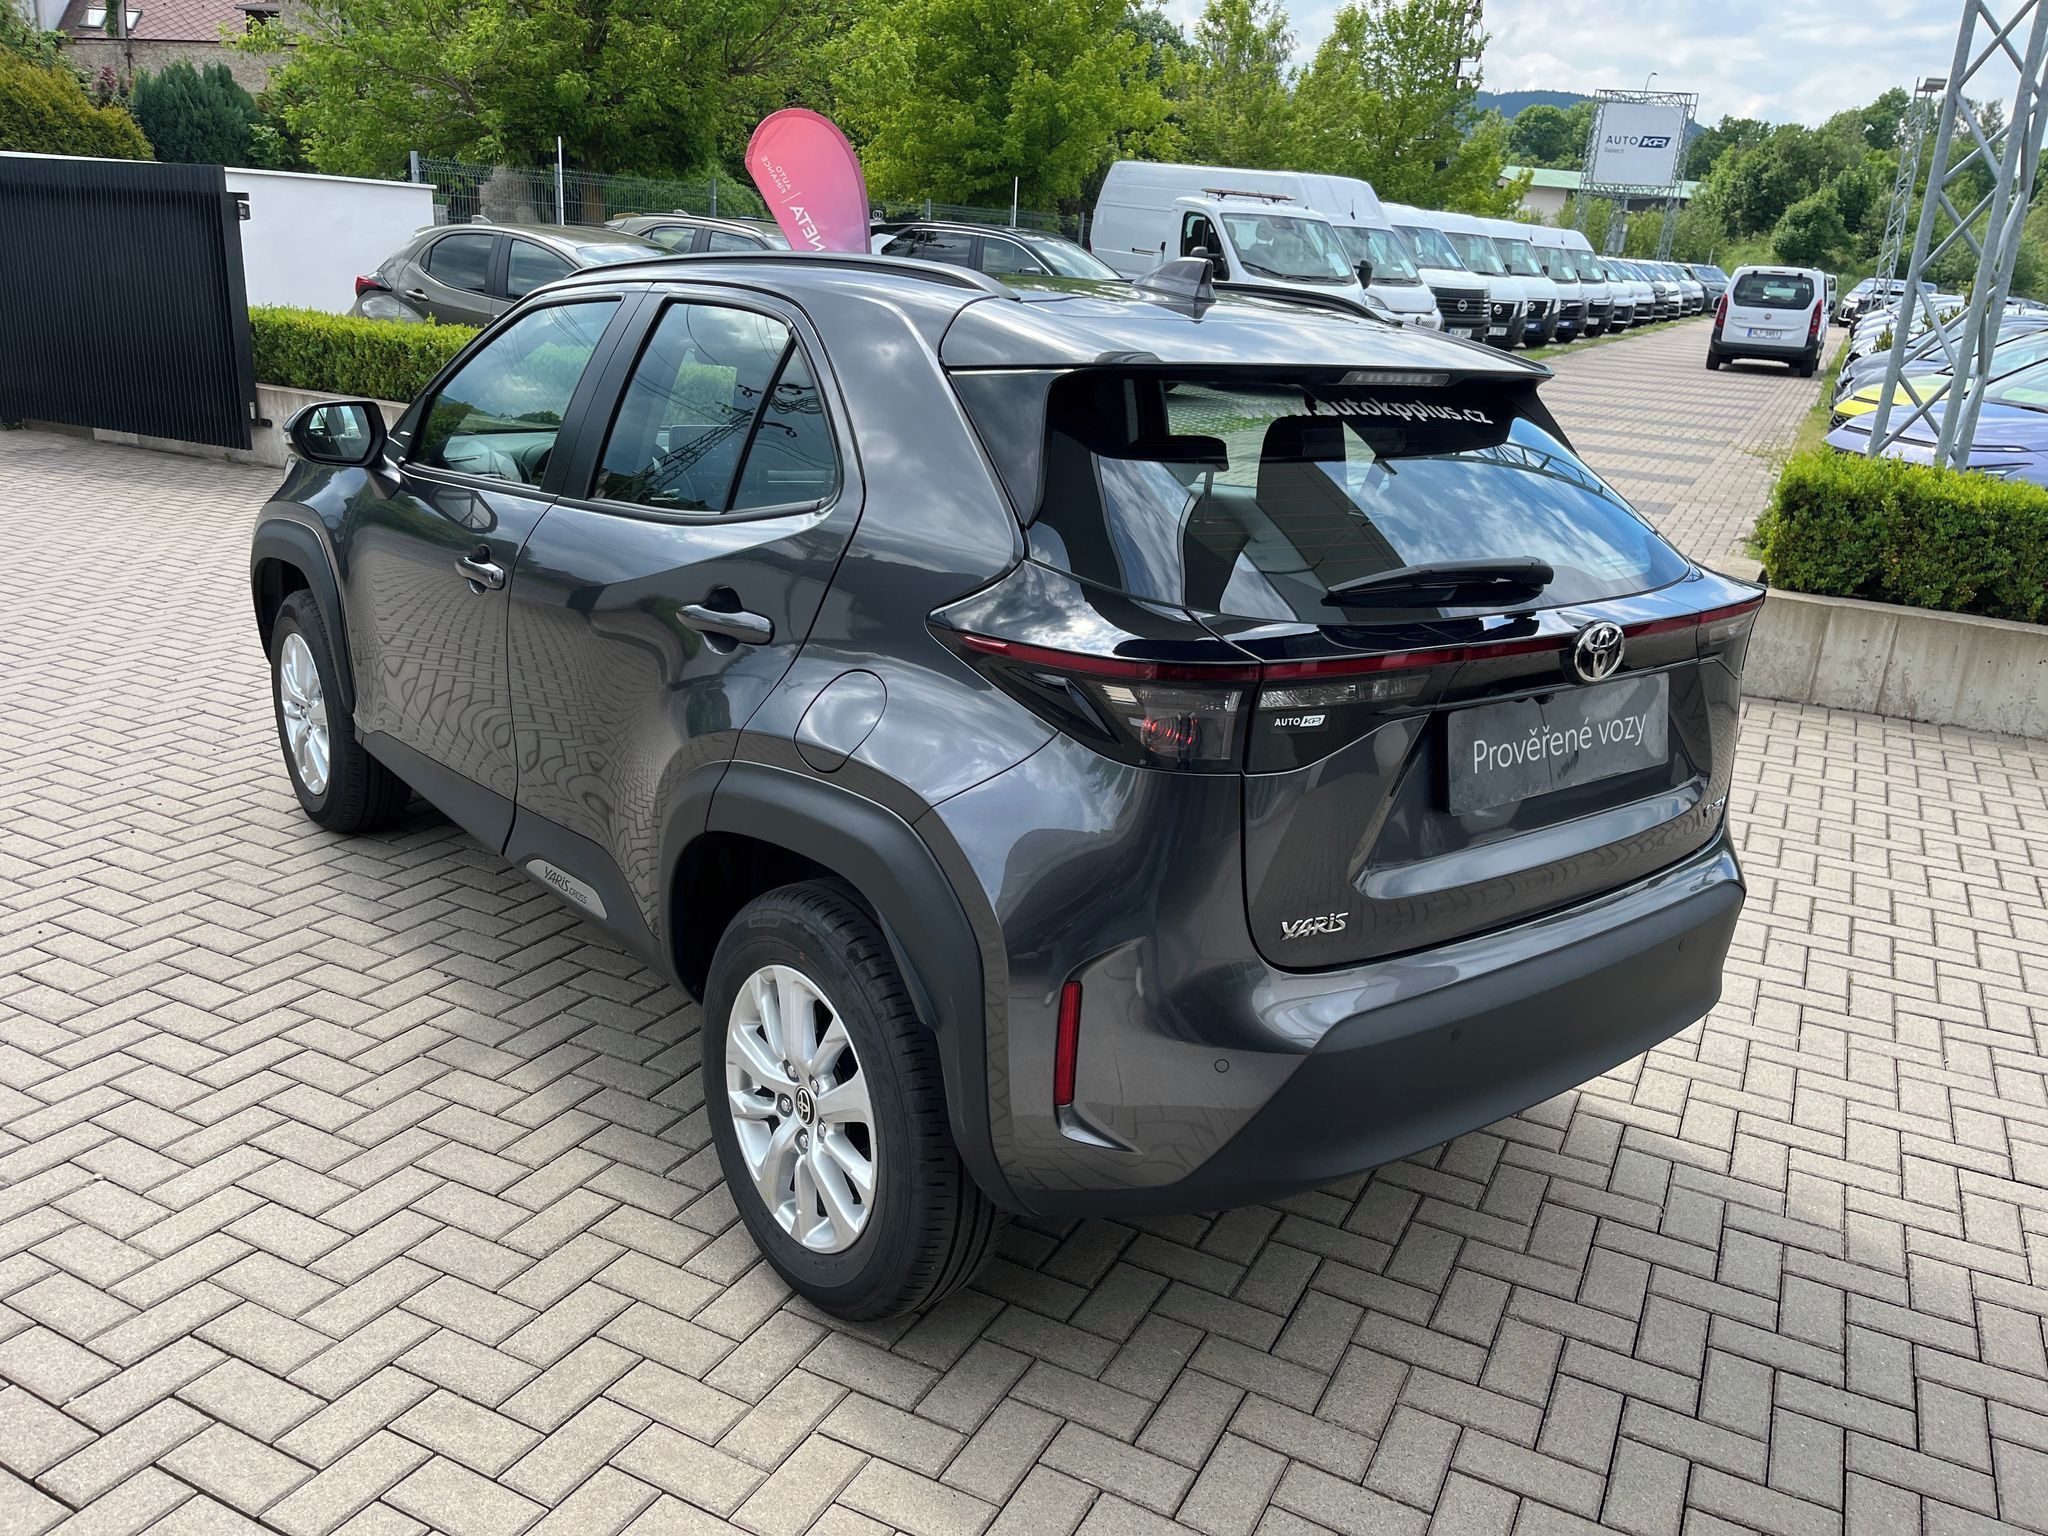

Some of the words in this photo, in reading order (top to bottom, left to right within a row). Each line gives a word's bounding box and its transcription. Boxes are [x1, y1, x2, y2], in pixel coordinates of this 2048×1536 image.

[1606, 135, 1638, 145] AUTO
[1274, 718, 1300, 726] AUTO
[1473, 716, 1592, 774] Prověřené
[1598, 713, 1647, 746] vozy
[569, 887, 587, 904] CROSS
